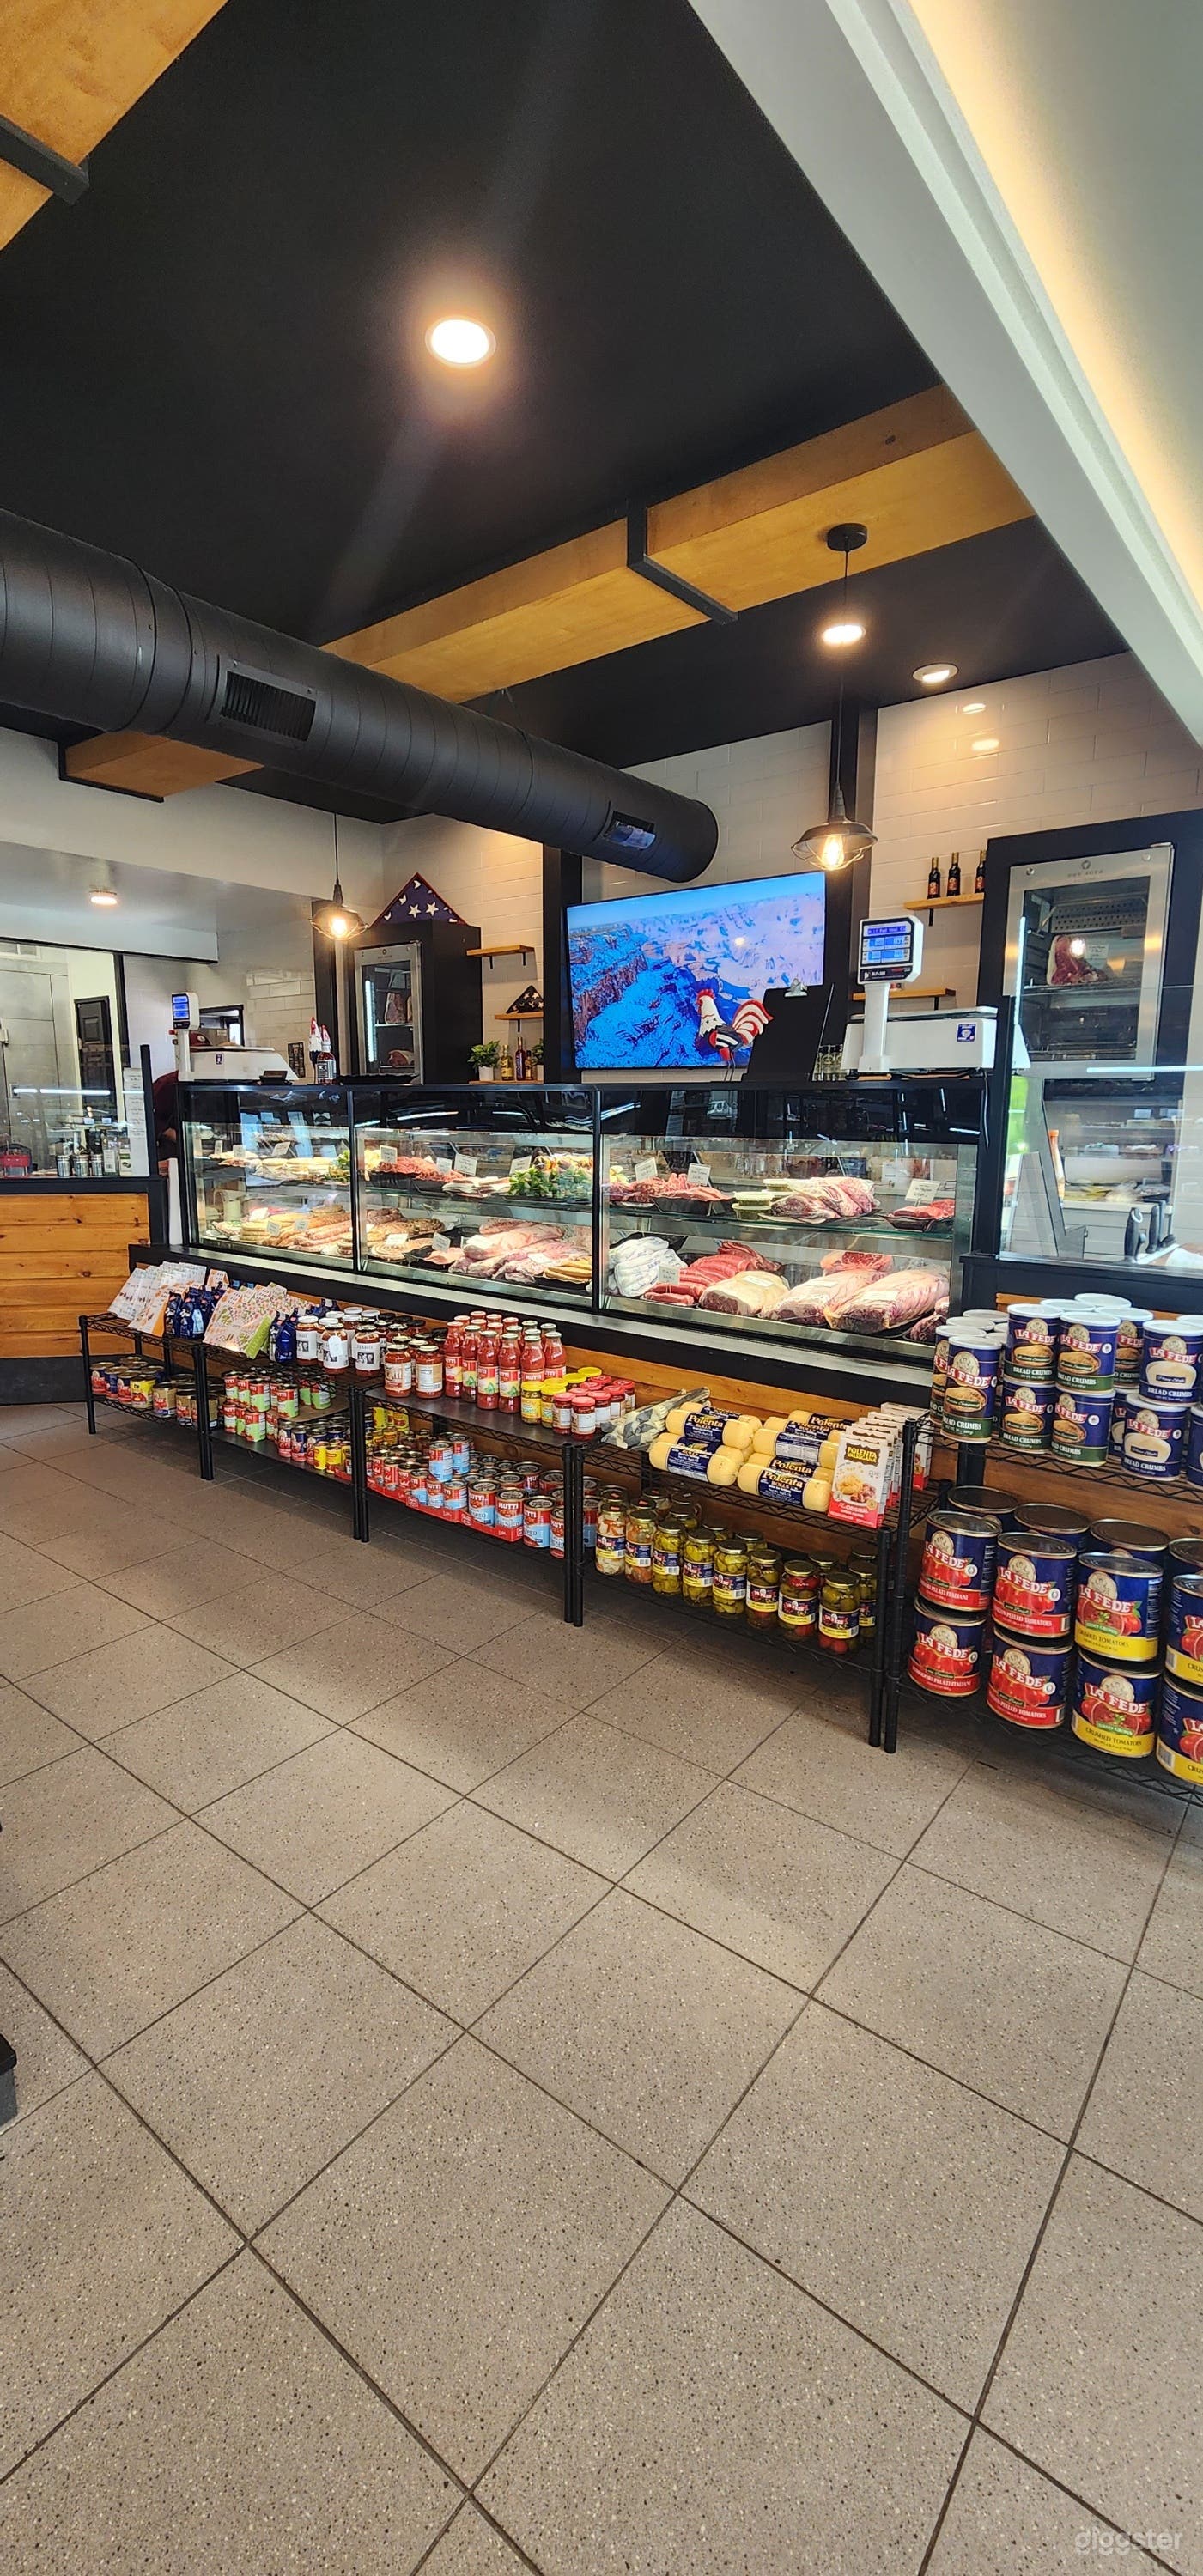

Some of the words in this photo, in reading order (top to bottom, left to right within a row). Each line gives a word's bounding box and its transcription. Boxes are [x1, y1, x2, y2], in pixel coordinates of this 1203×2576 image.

[1018, 1329, 1030, 1339] LA
[1073, 1339, 1100, 1352] FEDE
[1152, 1347, 1165, 1357] LA
[1168, 1352, 1196, 1364] FEDE
[958, 1374, 990, 1387] FEDE
[1008, 1397, 1018, 1406] LA
[1019, 1400, 1045, 1413] FEDE
[688, 1414, 723, 1428] Polenta
[1062, 1407, 1086, 1421] FEDE
[957, 1420, 982, 1431] CRUMBS
[1128, 1419, 1139, 1430] LA
[1142, 1425, 1170, 1438] FEDE
[771, 1459, 812, 1474] Polenta
[762, 1470, 804, 1488] Polenta
[935, 1548, 965, 1569] FEDE
[1000, 1567, 1012, 1580] LA
[1014, 1574, 1048, 1594] FEDE
[1079, 1584, 1091, 1599] LA
[1094, 1594, 1131, 1613] FEDE
[920, 1632, 933, 1648] LA
[937, 1642, 969, 1659] FEDE
[995, 1655, 1006, 1671] LA
[1009, 1668, 1042, 1688] FEDE
[1089, 1684, 1105, 1700] LA
[1109, 1695, 1146, 1714] FEDE
